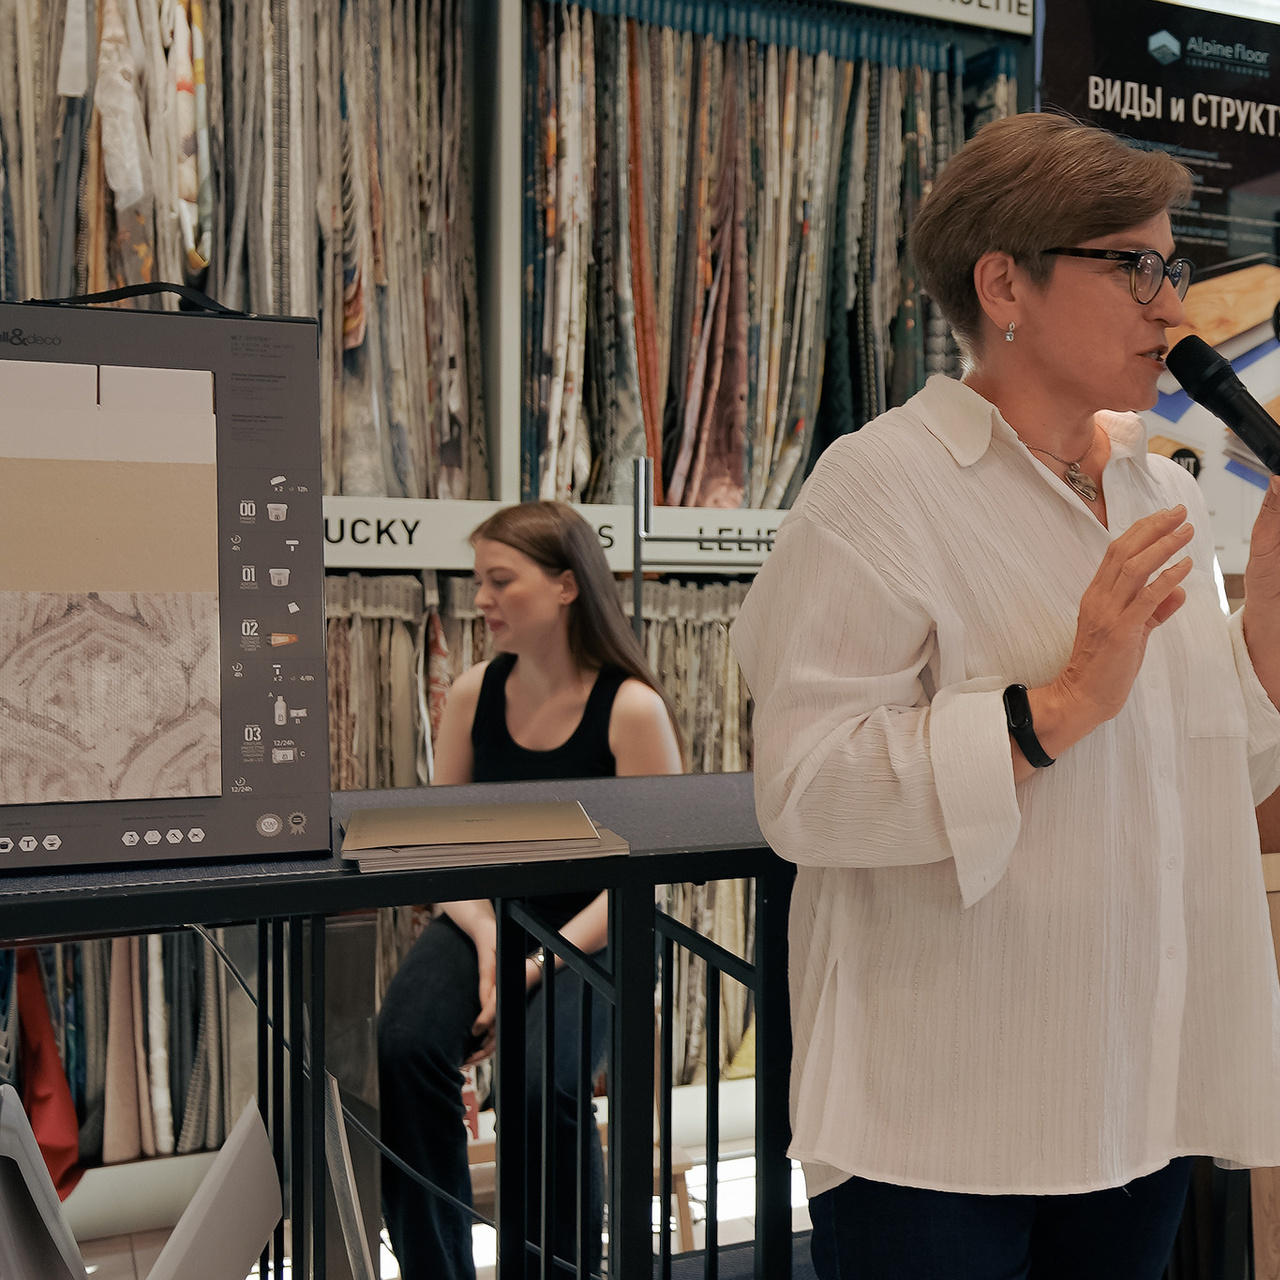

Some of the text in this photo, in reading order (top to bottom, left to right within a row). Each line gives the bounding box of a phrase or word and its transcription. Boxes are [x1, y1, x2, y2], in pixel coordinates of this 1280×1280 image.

[1186, 36, 1233, 58] Alpine
[1088, 75, 1163, 121] ВИДЫ
[1170, 97, 1185, 123] и
[240, 502, 256, 517] 00
[242, 568, 256, 582] 01
[241, 622, 259, 636] 02
[244, 726, 262, 741] 03
